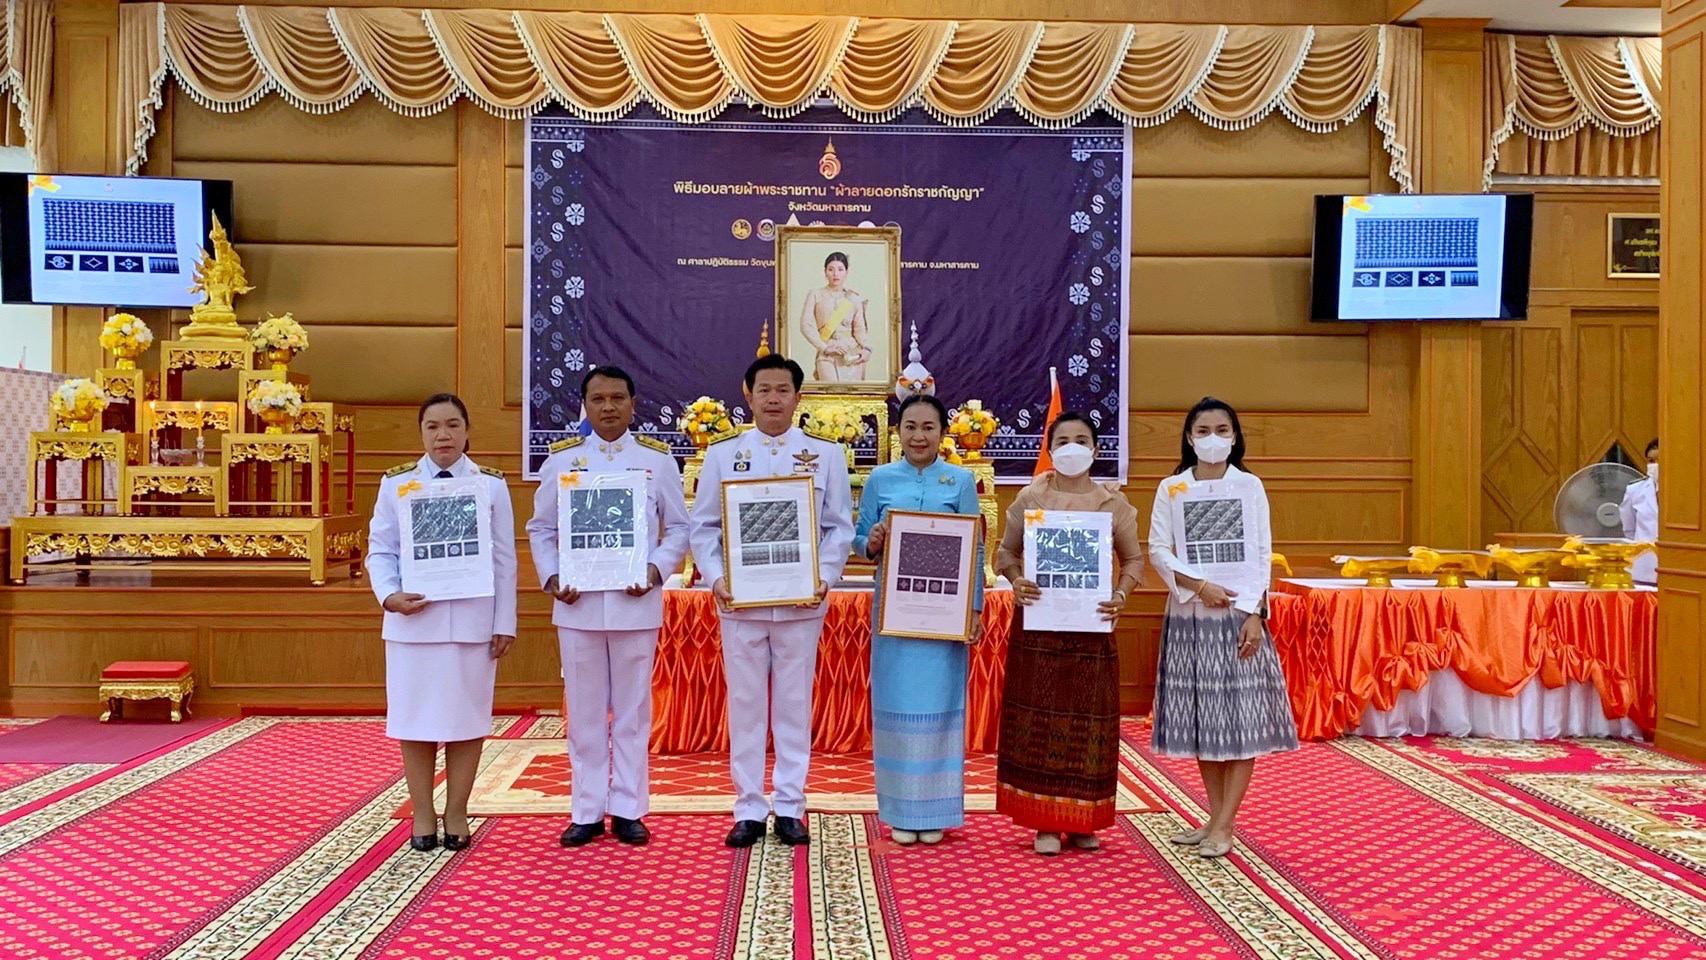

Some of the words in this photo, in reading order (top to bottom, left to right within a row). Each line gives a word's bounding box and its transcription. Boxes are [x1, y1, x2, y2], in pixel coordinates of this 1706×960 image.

[673, 181, 827, 196] พิธีมอบลายผ้าพระราชทาน
[788, 201, 871, 213] จังหวัดมหาสารคาม
[677, 258, 686, 266] ณ
